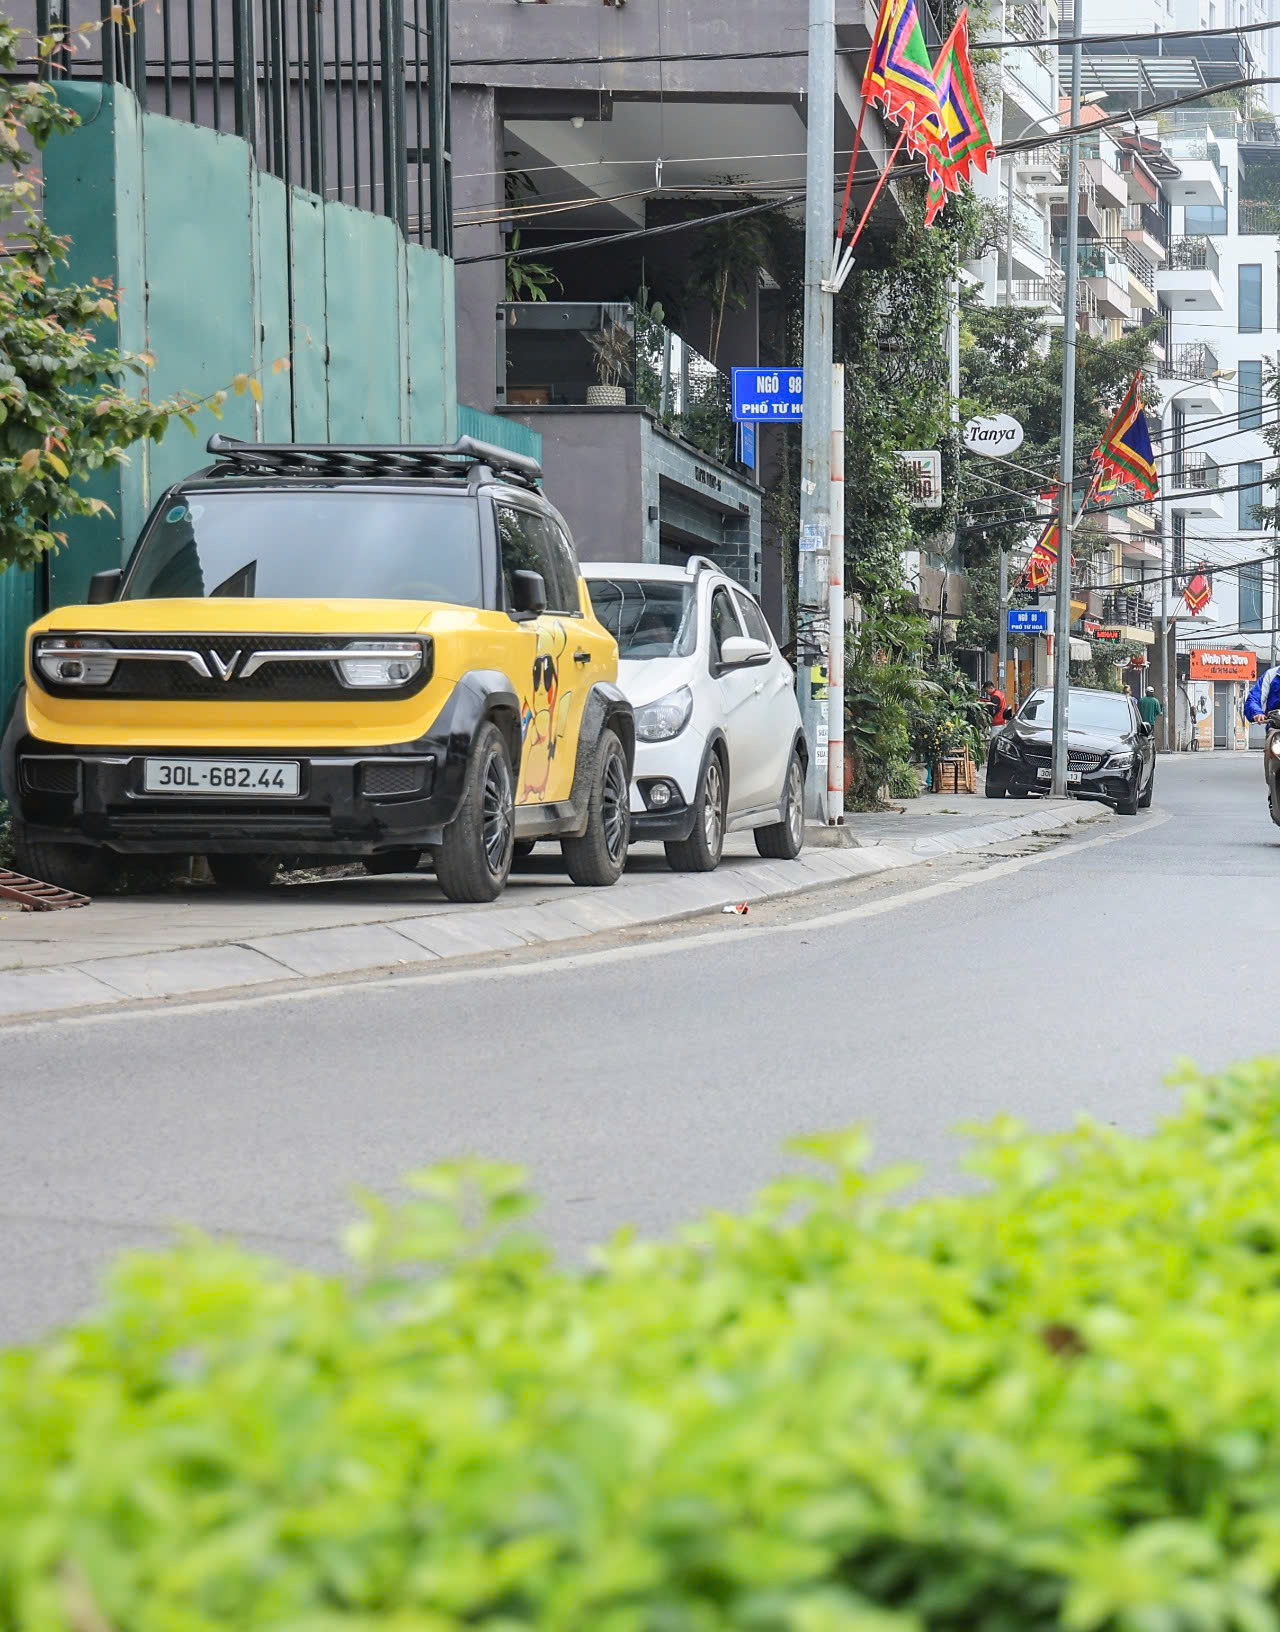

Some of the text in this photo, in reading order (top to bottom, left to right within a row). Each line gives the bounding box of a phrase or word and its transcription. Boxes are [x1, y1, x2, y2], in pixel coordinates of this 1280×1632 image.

[756, 372, 802, 394] NGÕ 98
[742, 400, 768, 414] PHỐ
[772, 401, 789, 414] TỪ
[970, 425, 1016, 445] Tanya
[159, 765, 285, 789] 30L-682.44
